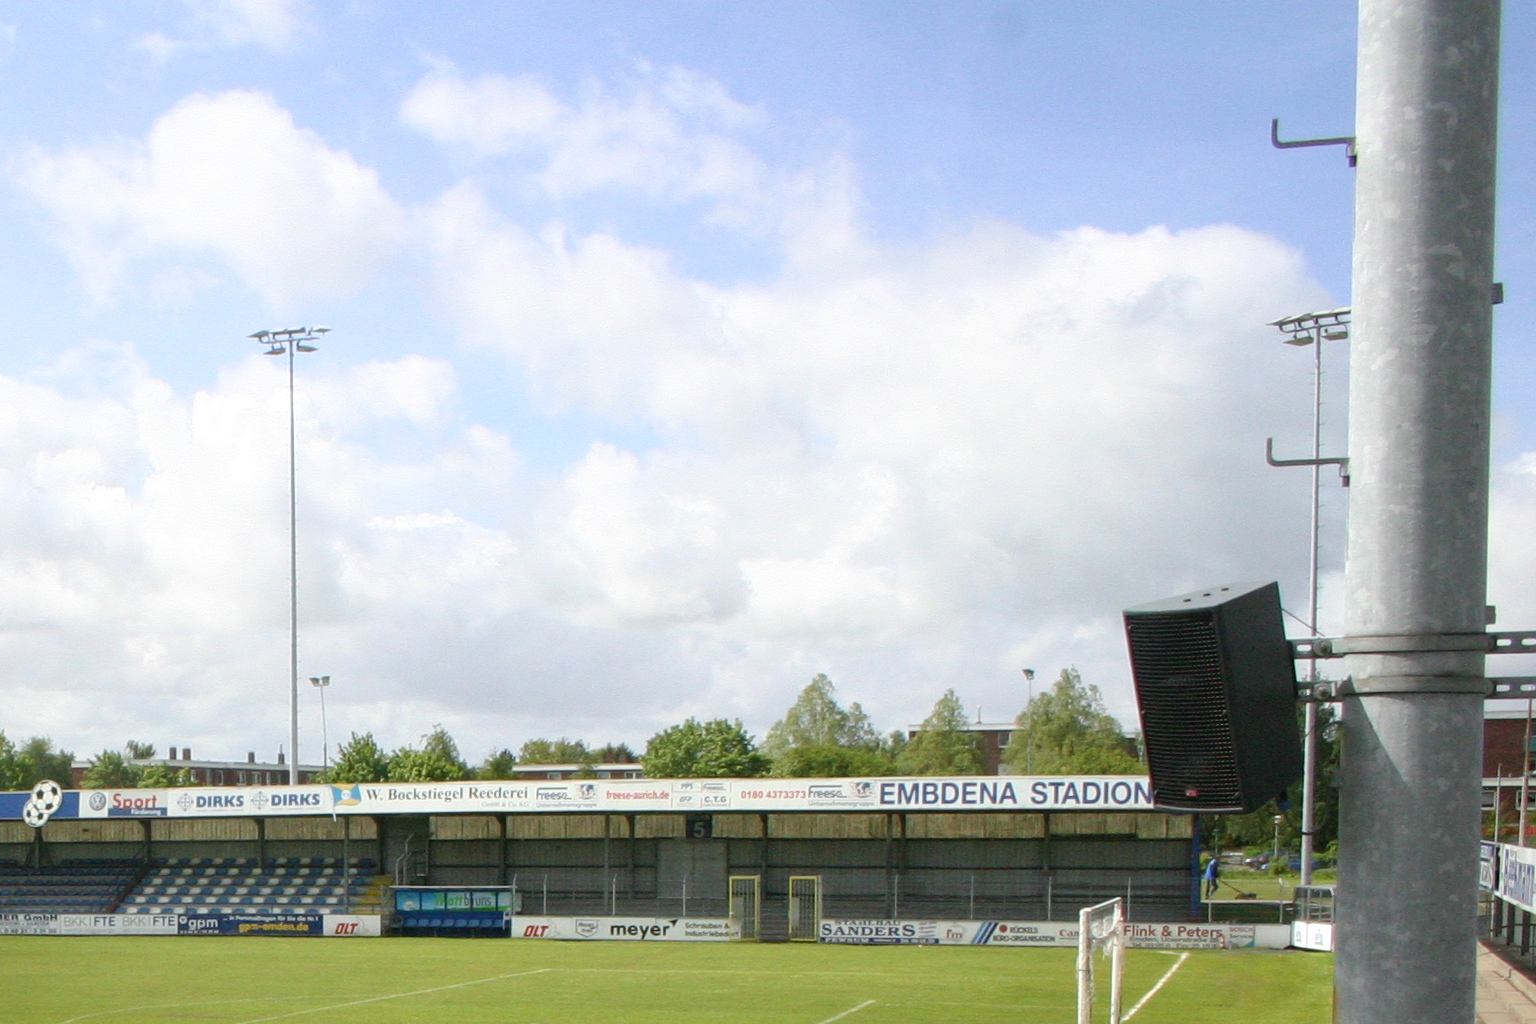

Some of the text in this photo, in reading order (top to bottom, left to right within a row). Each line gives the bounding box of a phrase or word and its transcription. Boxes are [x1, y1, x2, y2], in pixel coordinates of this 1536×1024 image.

[366, 786, 528, 803] W. Bockstiegel Reederei
[740, 790, 806, 799] 0180 4373373
[879, 781, 1152, 805] EMBDENA STADION
[112, 793, 158, 811] Sport
[195, 795, 245, 808] DIRKS
[270, 793, 320, 807] DIRKS
[63, 916, 88, 927] BKK
[93, 916, 116, 927] FTE
[121, 916, 176, 927] BKK FTE
[188, 917, 218, 930] gpm
[334, 923, 359, 935] OLT
[523, 925, 549, 937] OLT
[610, 924, 670, 940] meyer
[821, 923, 916, 937] SANDERS
[1123, 925, 1223, 938] Flink & Peters
